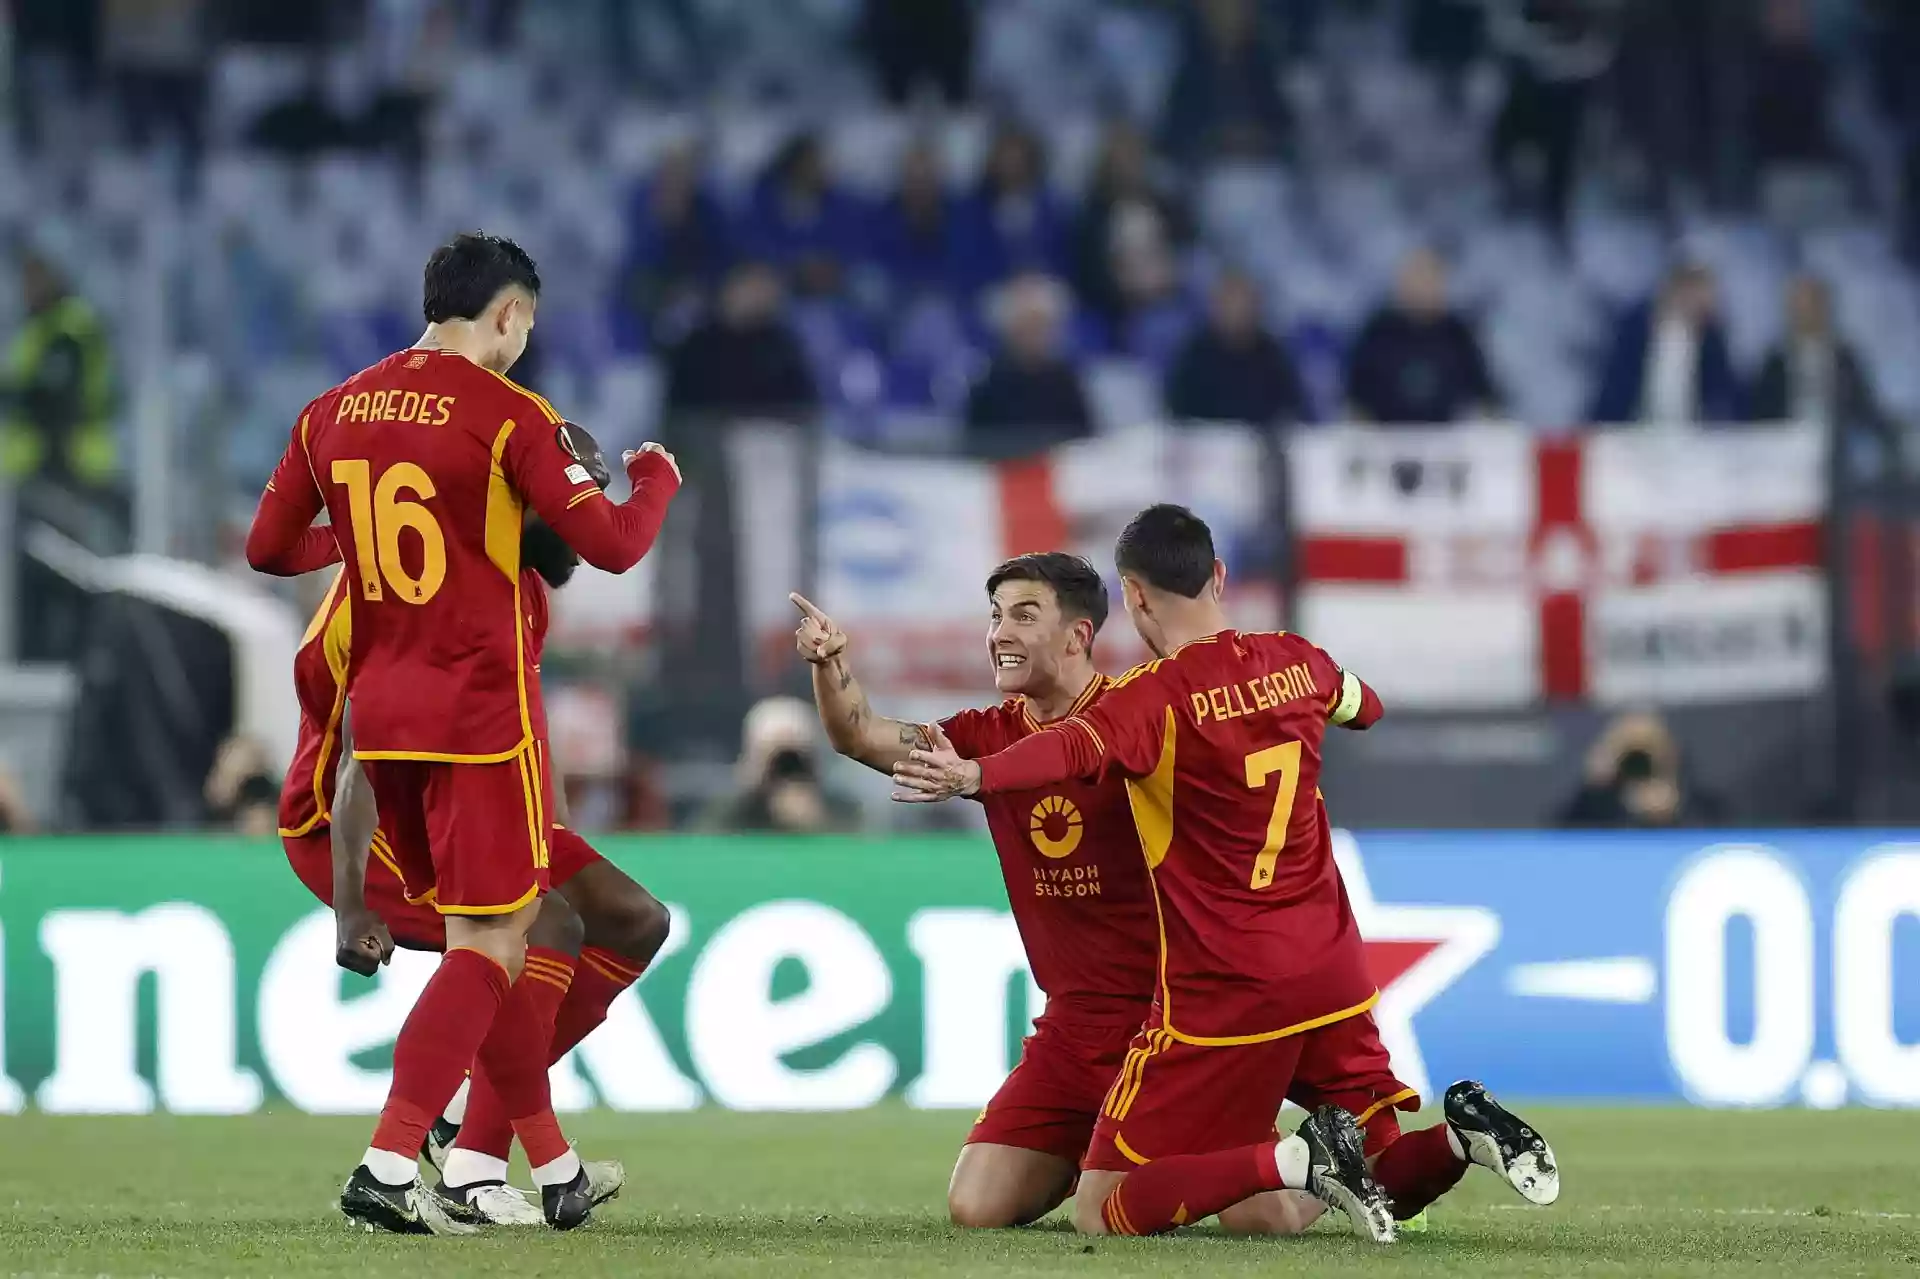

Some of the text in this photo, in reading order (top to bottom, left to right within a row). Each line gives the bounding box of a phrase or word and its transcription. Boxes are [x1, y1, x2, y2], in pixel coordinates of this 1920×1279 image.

[335, 389, 456, 426] PAREDES
[331, 459, 447, 605] 16
[1190, 662, 1318, 726] PELLEGRINI
[1244, 740, 1302, 890] 7
[1035, 881, 1101, 898] SEASON
[0, 856, 1046, 1115] neen
